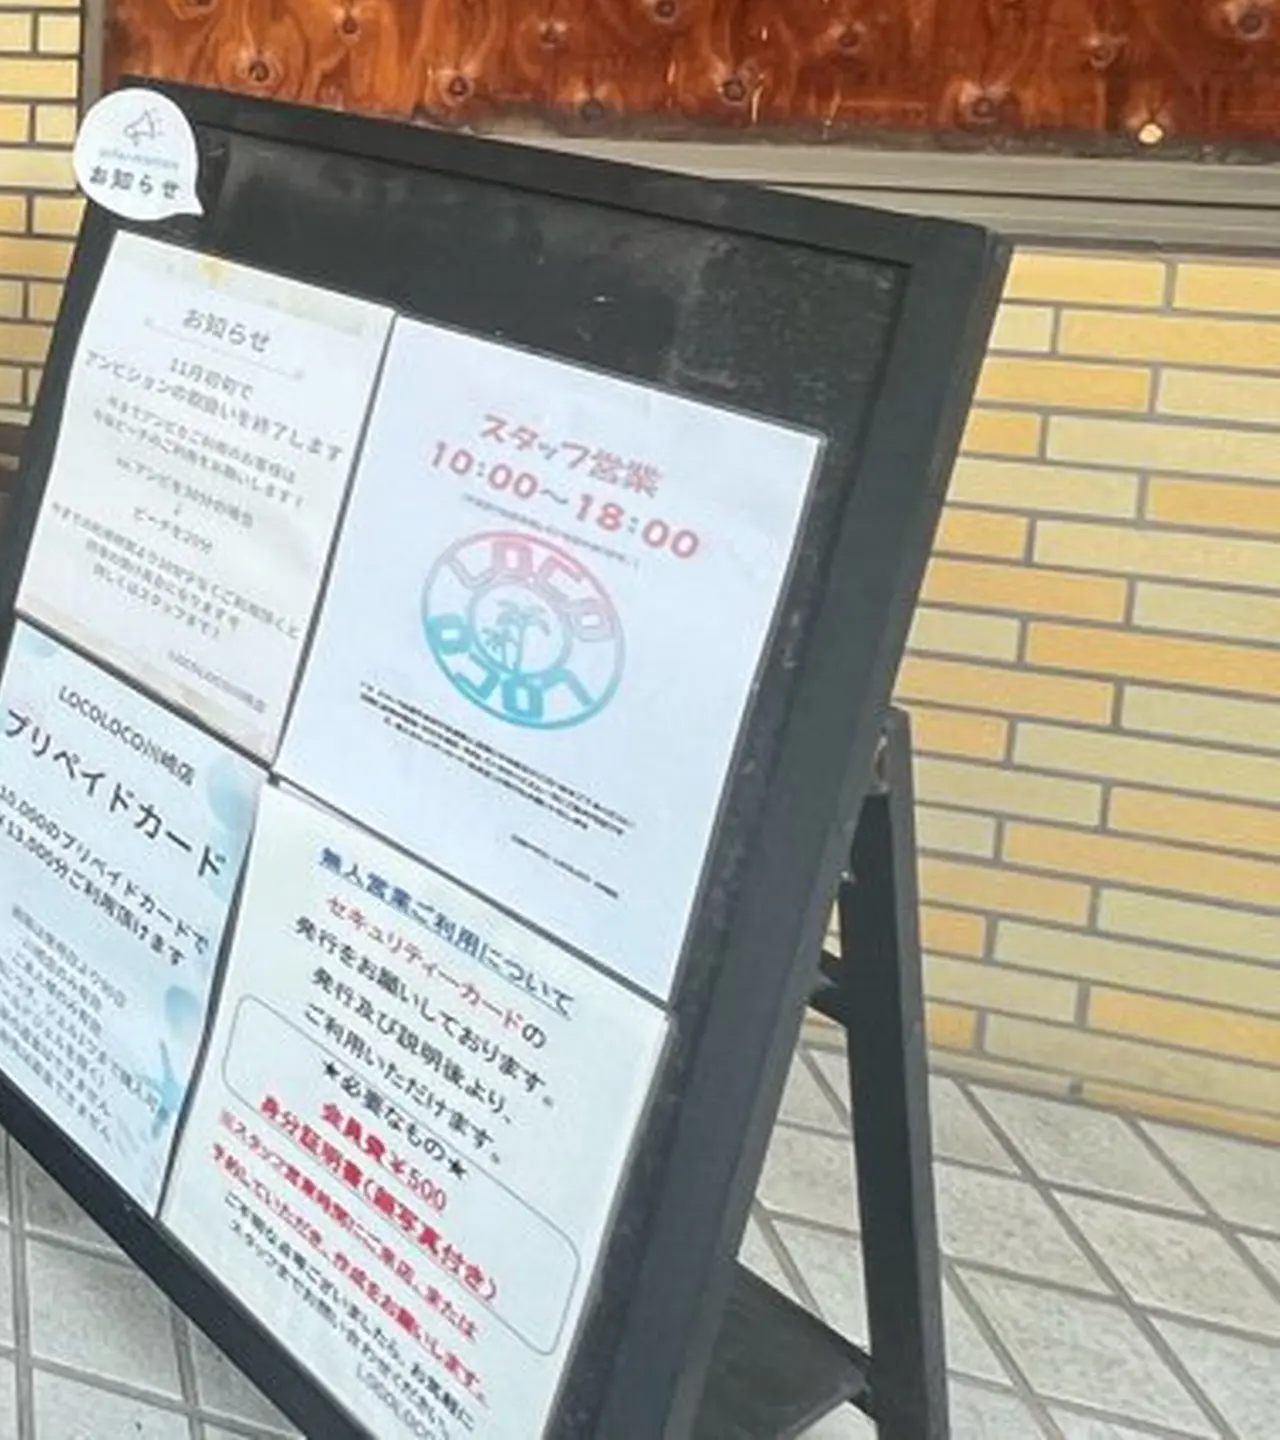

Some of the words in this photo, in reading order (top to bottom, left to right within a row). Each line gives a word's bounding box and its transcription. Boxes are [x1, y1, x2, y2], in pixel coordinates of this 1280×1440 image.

[89, 166, 179, 199] お知らせ
[180, 304, 273, 356] お知らせ
[477, 410, 664, 501] スタッフ営業
[3, 705, 227, 888] プリペイドカード
[57, 683, 195, 788] LOCOLOCO川崎店
[293, 911, 560, 1109] 発行をお願いしております。
[317, 843, 576, 1019] 無人営業ご利用について
[325, 892, 548, 1054] セキュリティーカードの
[302, 998, 507, 1167] ご利用いただけます。
[310, 963, 518, 1127] 発行及び説明後より、
